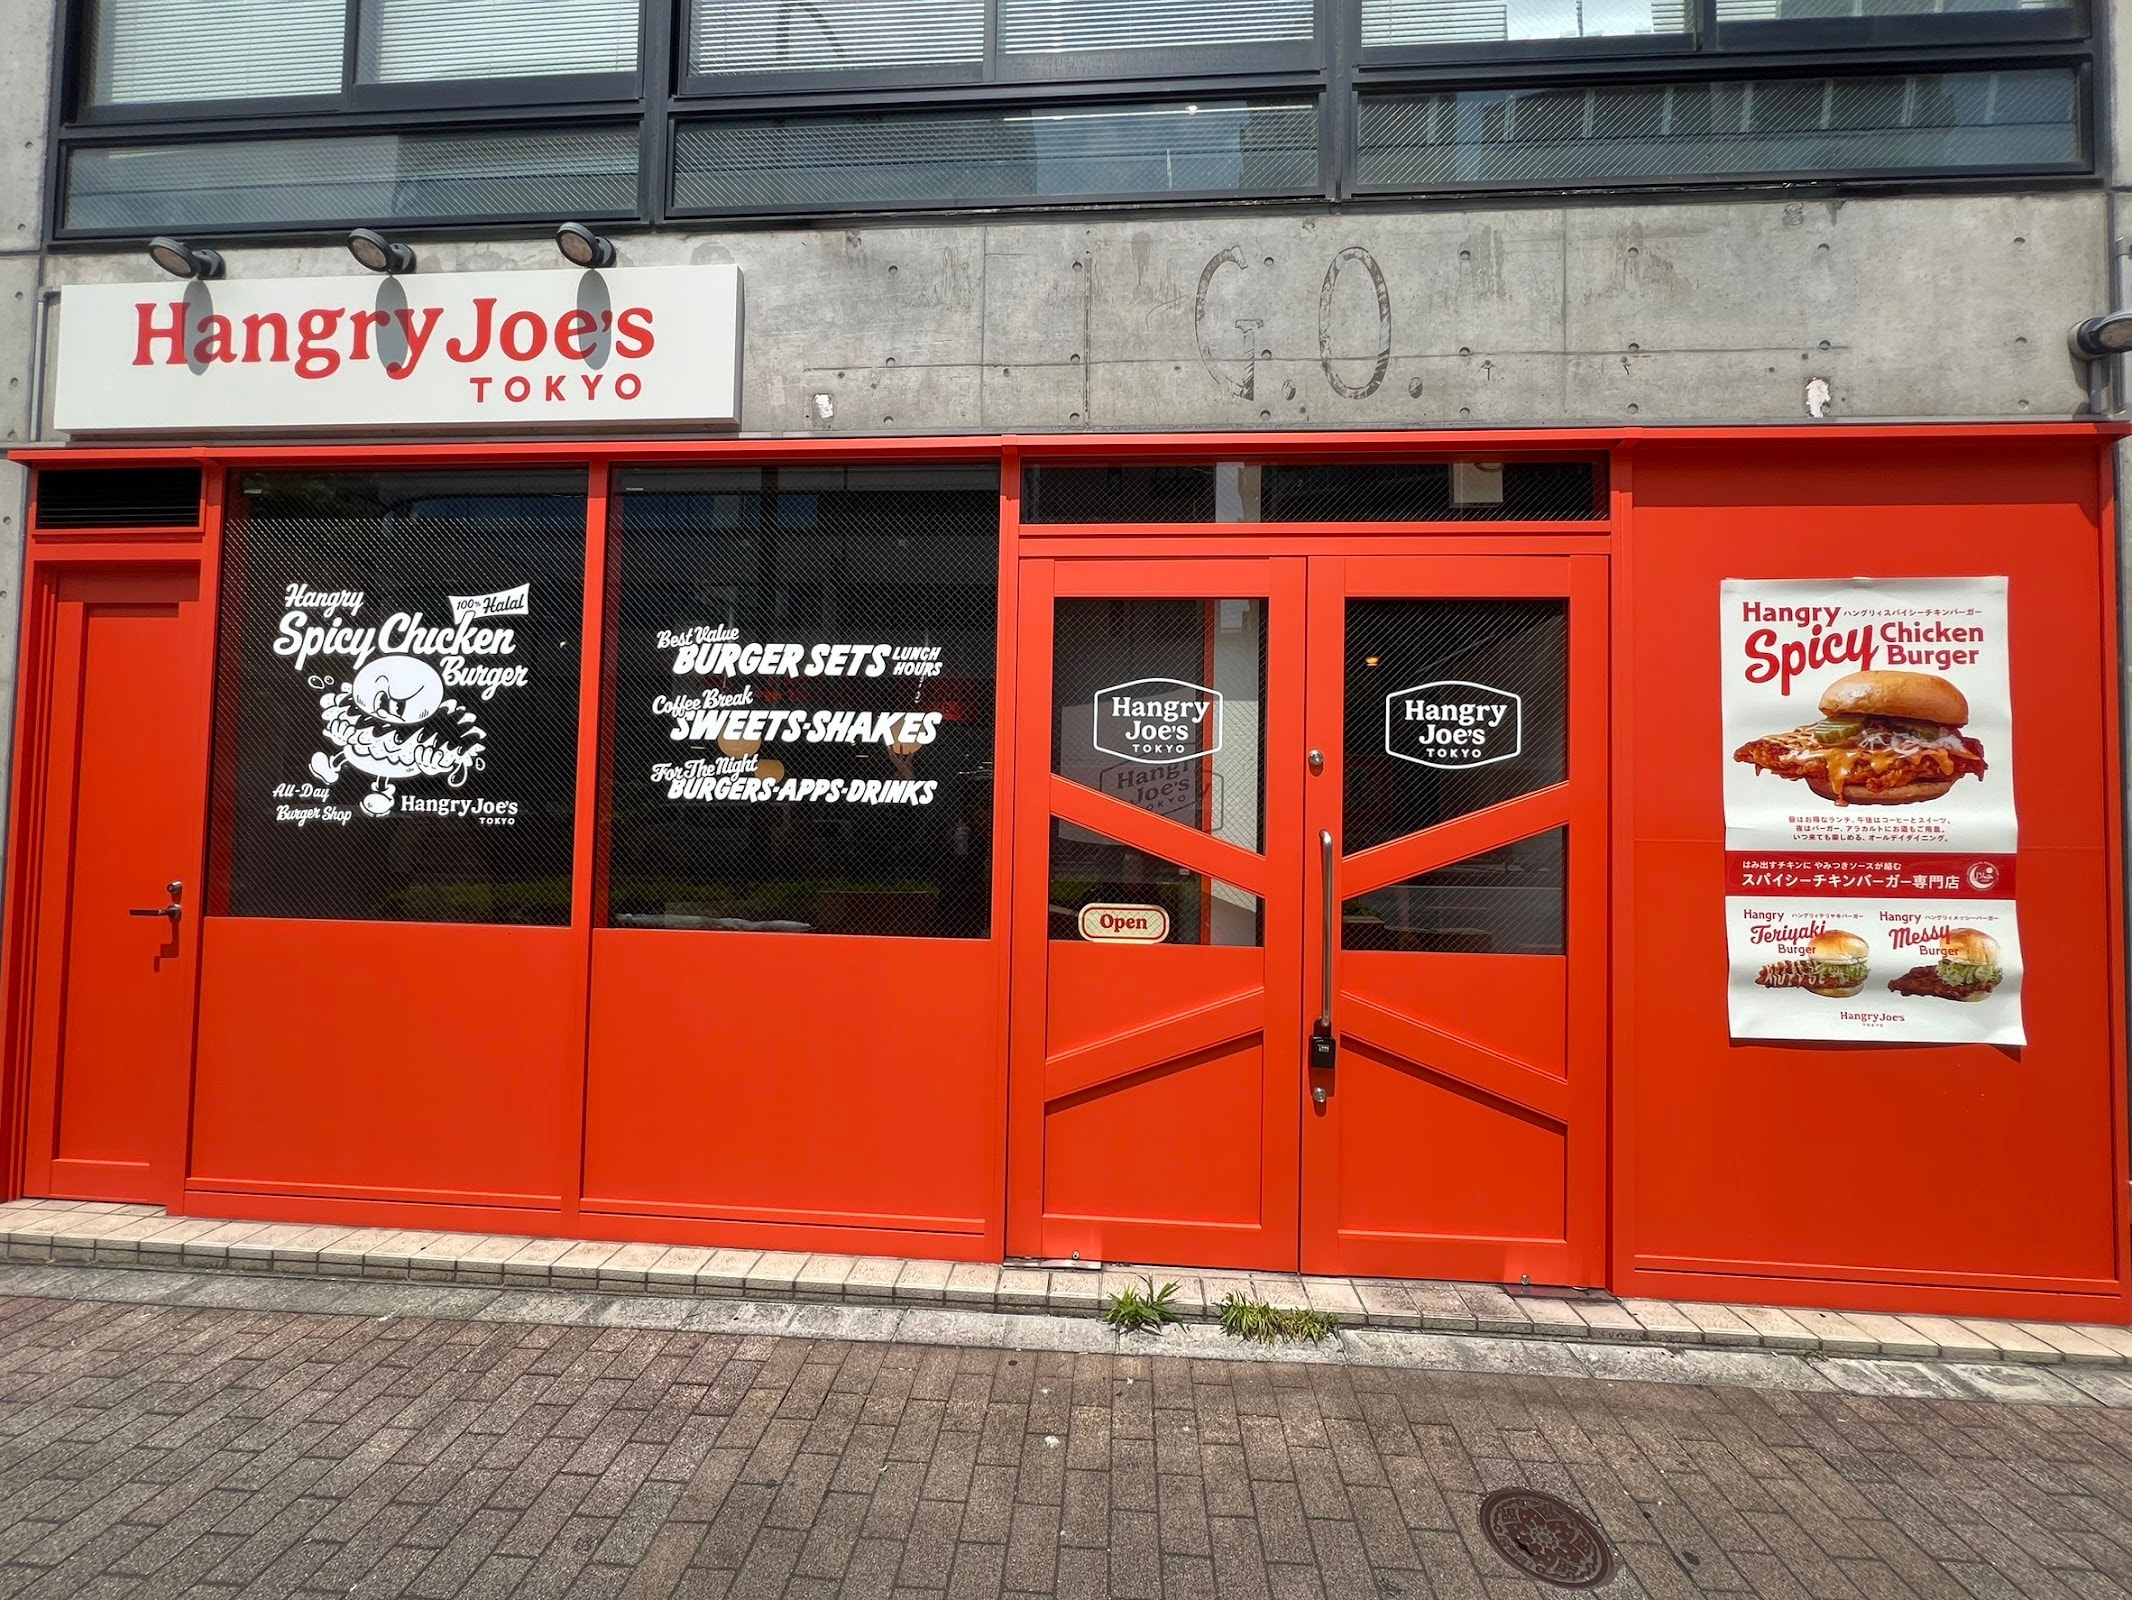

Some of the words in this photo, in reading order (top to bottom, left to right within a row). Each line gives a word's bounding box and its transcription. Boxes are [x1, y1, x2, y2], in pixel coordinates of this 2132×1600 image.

[469, 373, 643, 404] TOKYO
[285, 583, 364, 618] Hangry
[457, 598, 481, 610] 100%
[483, 593, 524, 614] Halal
[1742, 601, 1841, 628] Hangry
[273, 610, 376, 670] Spicy
[378, 611, 517, 655] Chicken
[656, 629, 693, 649] Best
[694, 623, 740, 646] Value
[1880, 621, 1984, 643] Chicken
[672, 643, 804, 679] BURGER
[804, 643, 893, 677] SETS
[892, 646, 942, 661] LUNCH
[1744, 624, 1880, 696] Spicy
[1887, 644, 1980, 670] Burger
[440, 655, 529, 700] Burger
[893, 662, 943, 677] HOURS
[652, 695, 701, 718] Coffee
[702, 685, 753, 709] Break
[1111, 697, 1210, 723] Hangry
[1405, 700, 1508, 727] Hangry
[1125, 720, 1189, 741] Joe's
[1418, 724, 1486, 745] Joe's
[1132, 744, 1185, 753] TOKYO
[1426, 748, 1482, 758] TOKYO
[650, 763, 685, 782] For
[684, 759, 715, 778] The
[715, 754, 758, 782] Night
[272, 783, 330, 802] All-Day
[276, 805, 321, 826] Burger
[322, 805, 352, 825] Shop
[479, 817, 515, 825] TOKYO
[1742, 860, 1811, 870] はみ出すチキンに
[1742, 873, 1960, 889] スパイシーチキンバーガー専門店
[1099, 913, 1148, 933] Open
[1744, 909, 1784, 922] Hangry
[1880, 911, 1921, 924] Hangry
[1750, 920, 1826, 945] Teriyaki
[1888, 925, 1951, 949] Messy
[1778, 944, 1816, 956] Burger
[1920, 945, 1959, 957] Burger
